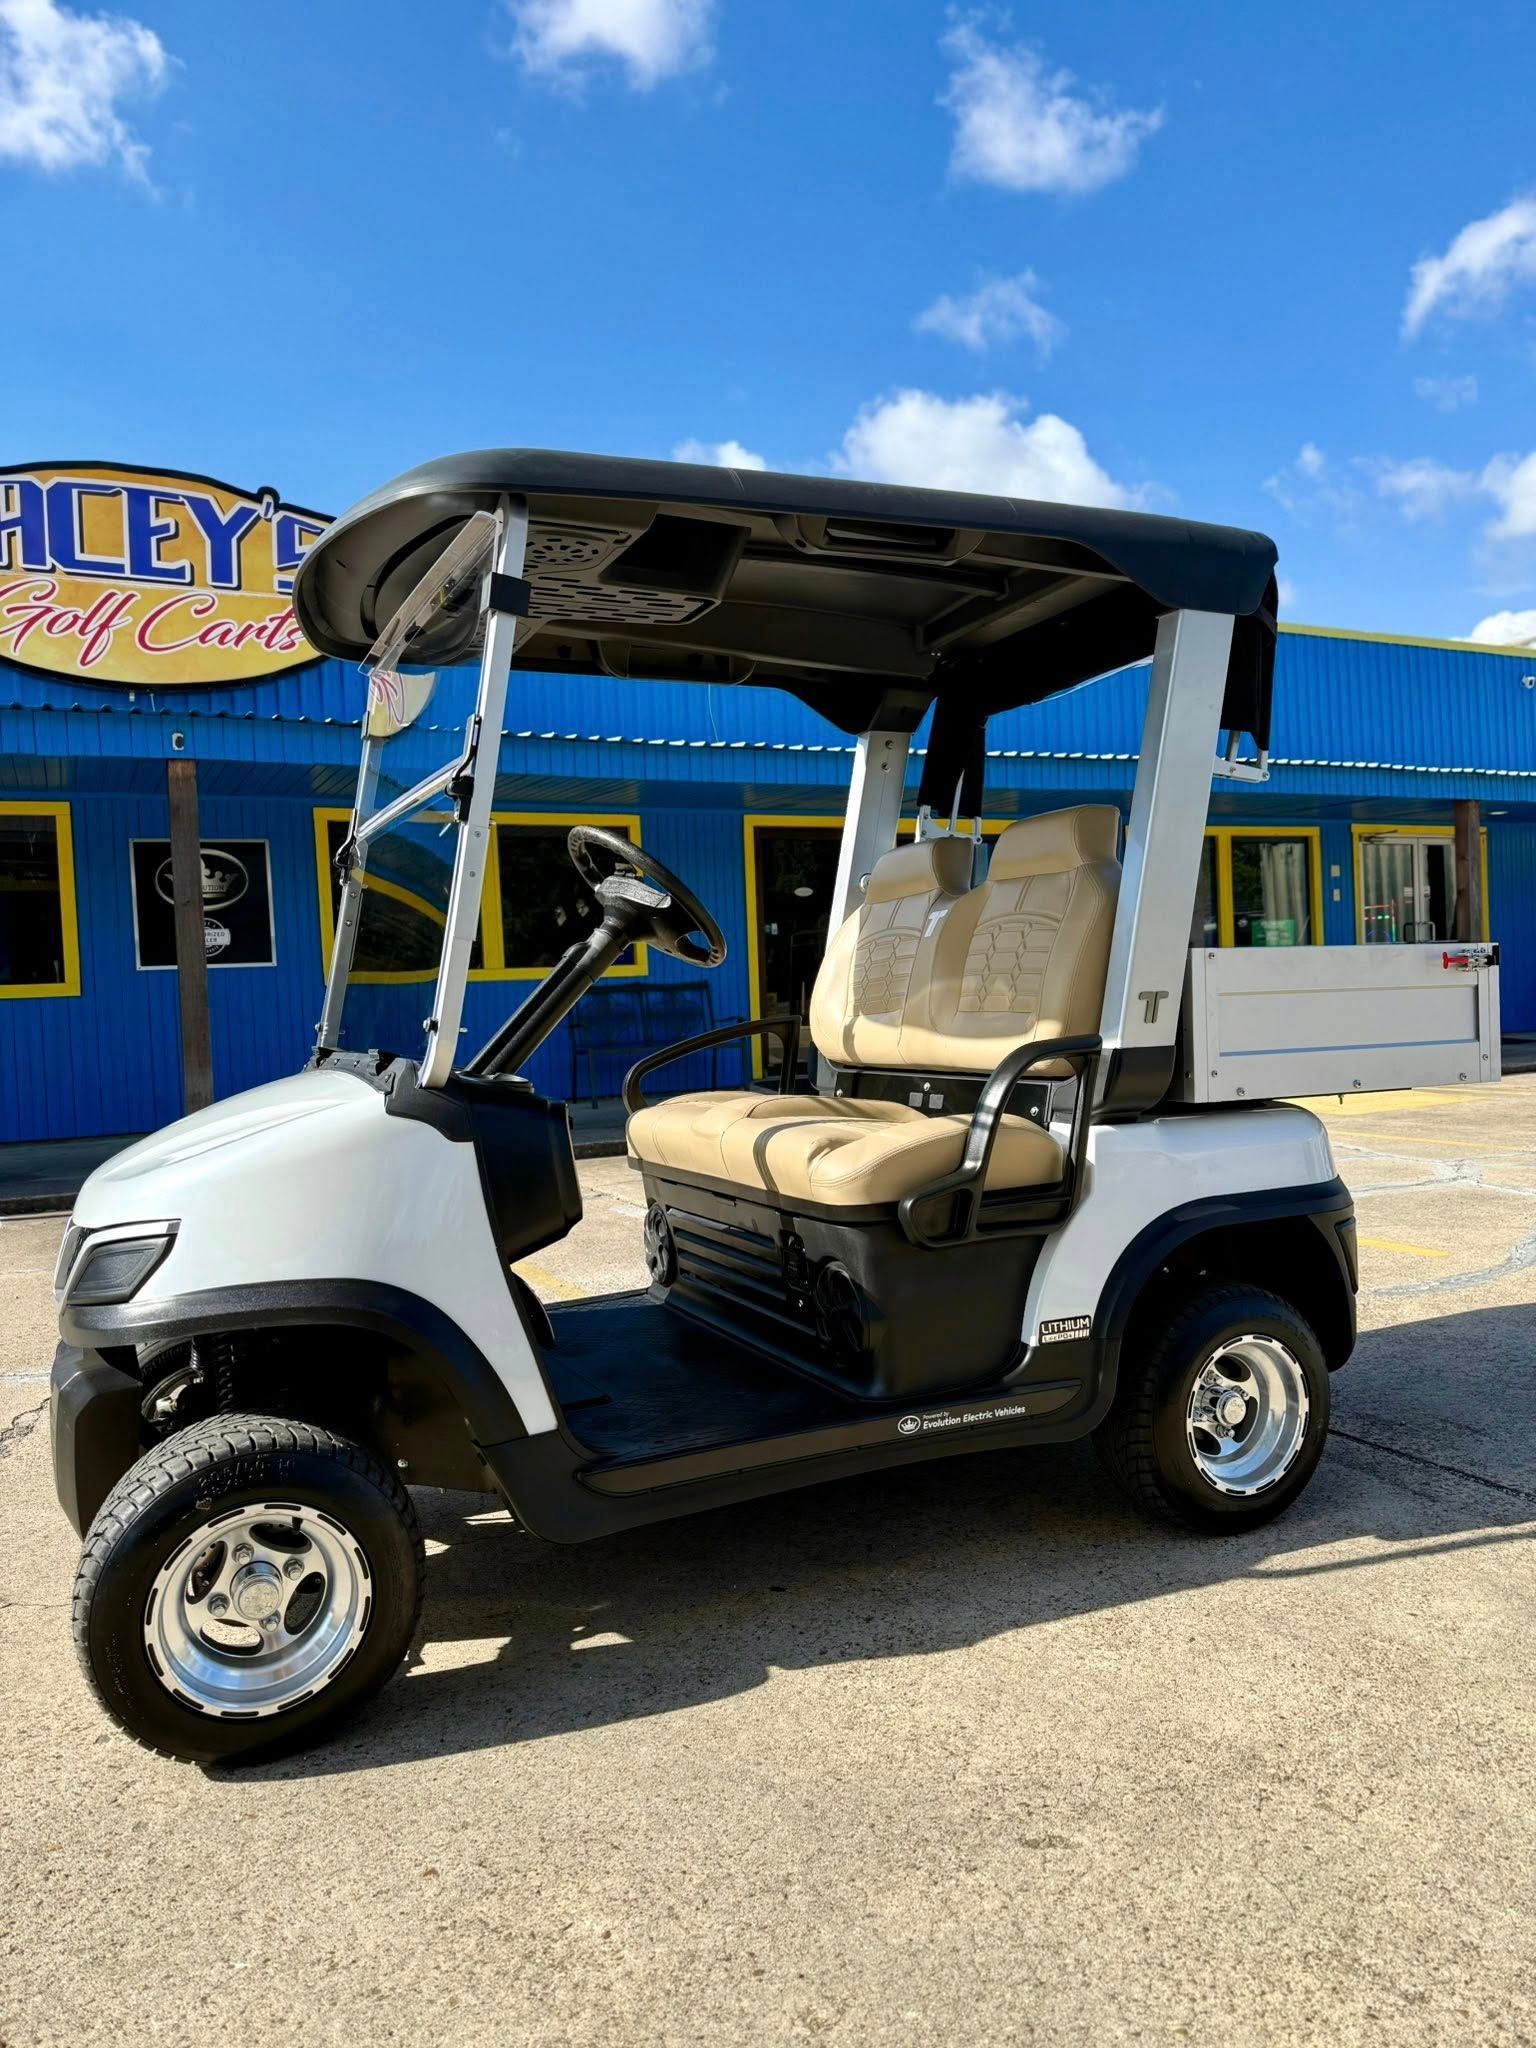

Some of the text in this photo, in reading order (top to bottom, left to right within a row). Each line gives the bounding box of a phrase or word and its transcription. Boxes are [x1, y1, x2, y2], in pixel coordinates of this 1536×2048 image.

[0, 578, 304, 668] Golf Carts
[1041, 1316, 1090, 1334] LITHIUM
[923, 1405, 1026, 1430] Evolution Electric Vehicles
